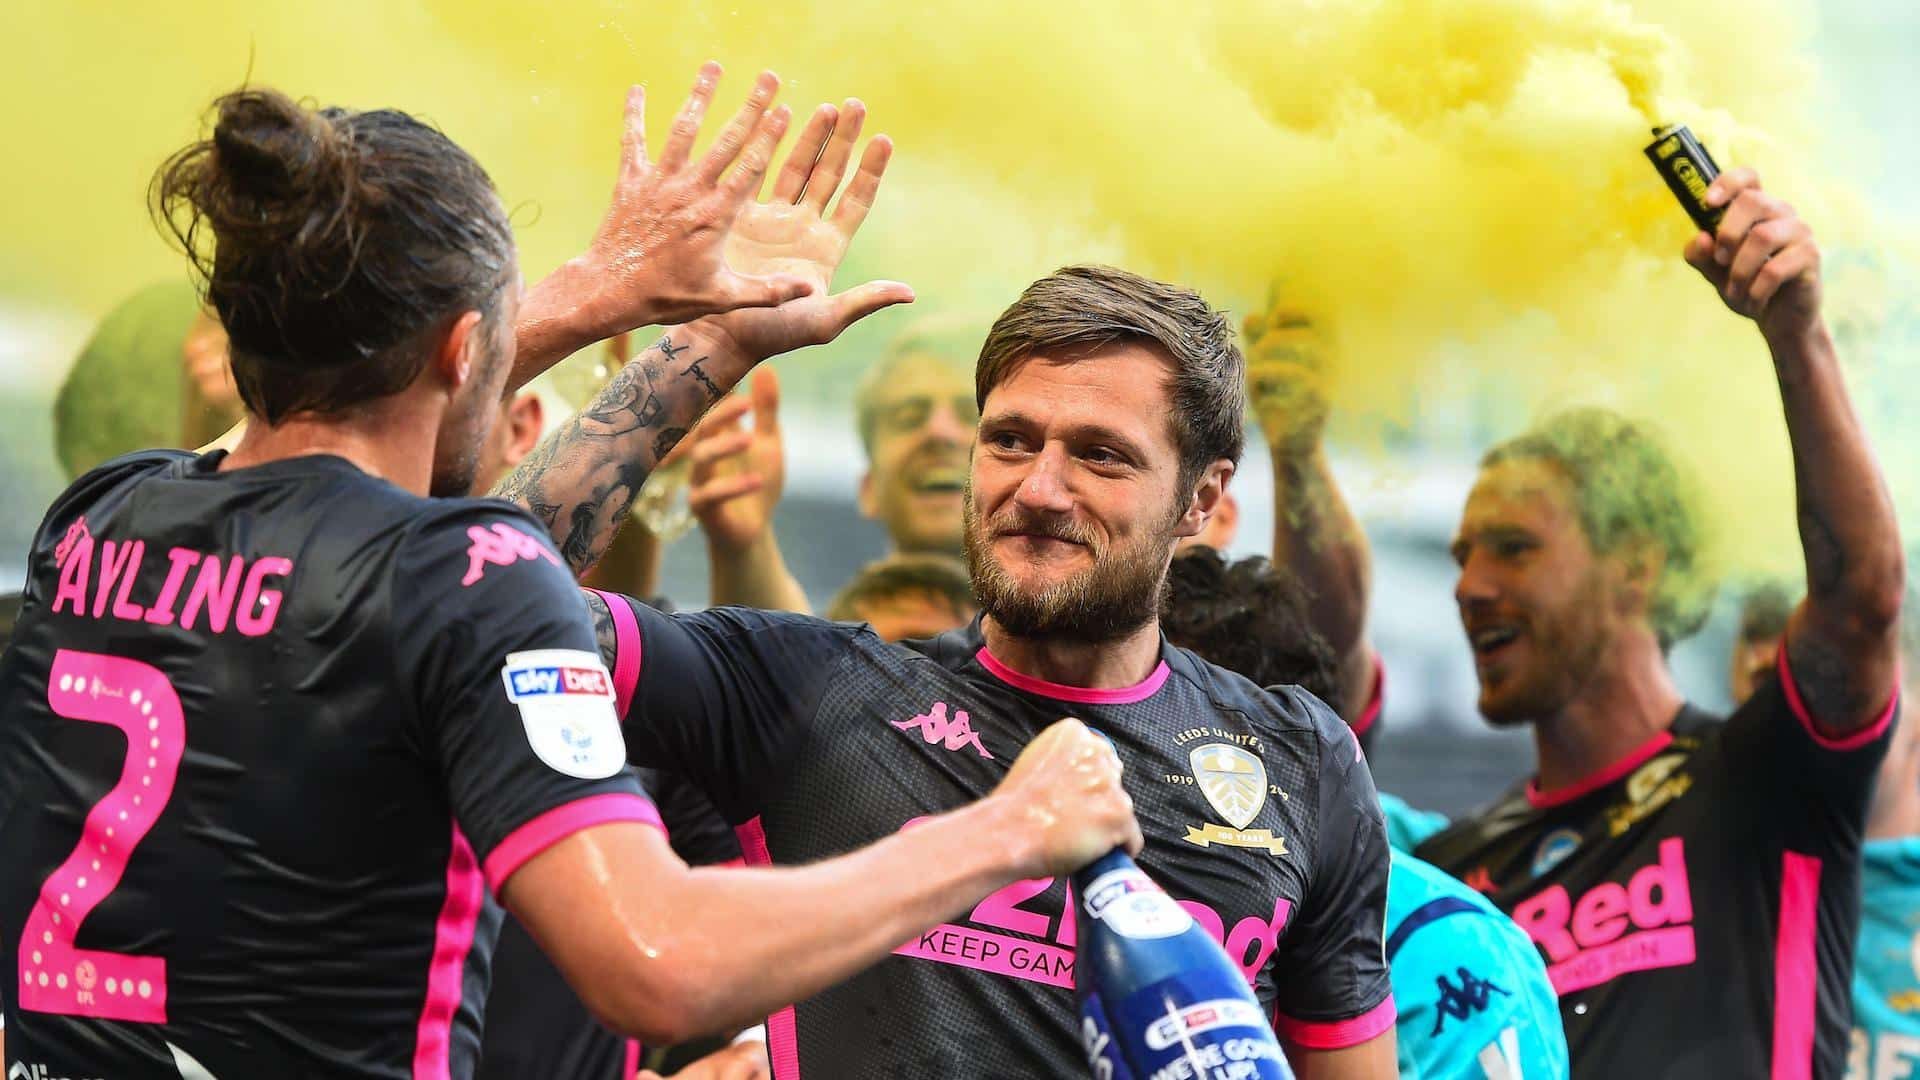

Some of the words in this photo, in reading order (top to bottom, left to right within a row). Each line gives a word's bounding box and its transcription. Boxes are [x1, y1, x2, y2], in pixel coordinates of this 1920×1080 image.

[52, 537, 293, 636] AYLING
[1172, 727, 1210, 746] LEEDS
[1165, 774, 1194, 786] 1919
[18, 649, 186, 1023] 2
[1512, 836, 1694, 965] Red
[919, 930, 1000, 962] KEEP
